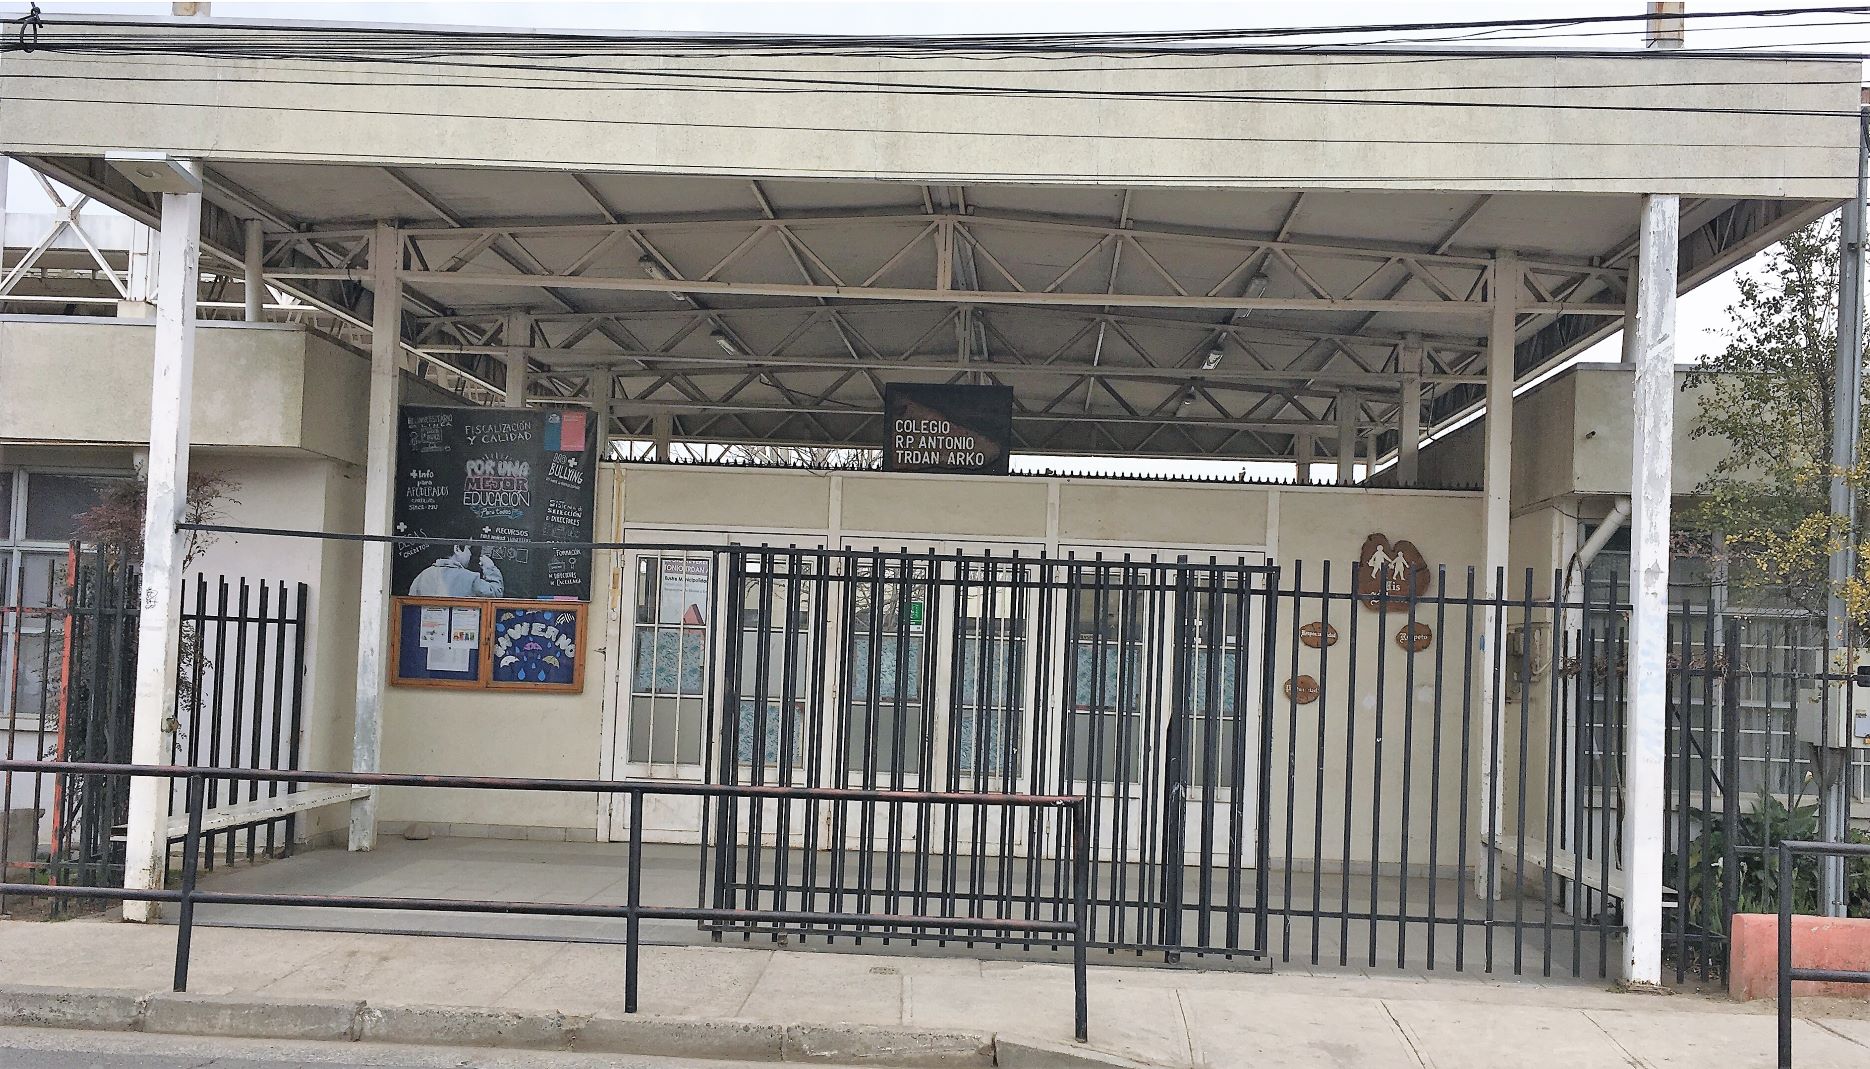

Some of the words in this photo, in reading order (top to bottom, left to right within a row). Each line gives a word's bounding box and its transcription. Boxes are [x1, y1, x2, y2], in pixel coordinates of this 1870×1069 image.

[465, 421, 531, 435] FISCALIZACIÓN
[895, 419, 950, 434] COLEGIO
[467, 436, 476, 445] Y
[481, 432, 532, 443] CALIDAD
[918, 435, 975, 450] ANTONIO
[895, 450, 940, 464] TRDAN
[947, 451, 985, 466] ARKO
[466, 459, 495, 477] POR
[497, 459, 530, 478] UNA
[548, 462, 584, 484] BULLYING
[464, 476, 529, 492] MEJOR
[463, 489, 530, 507] EDUCACIÓN
